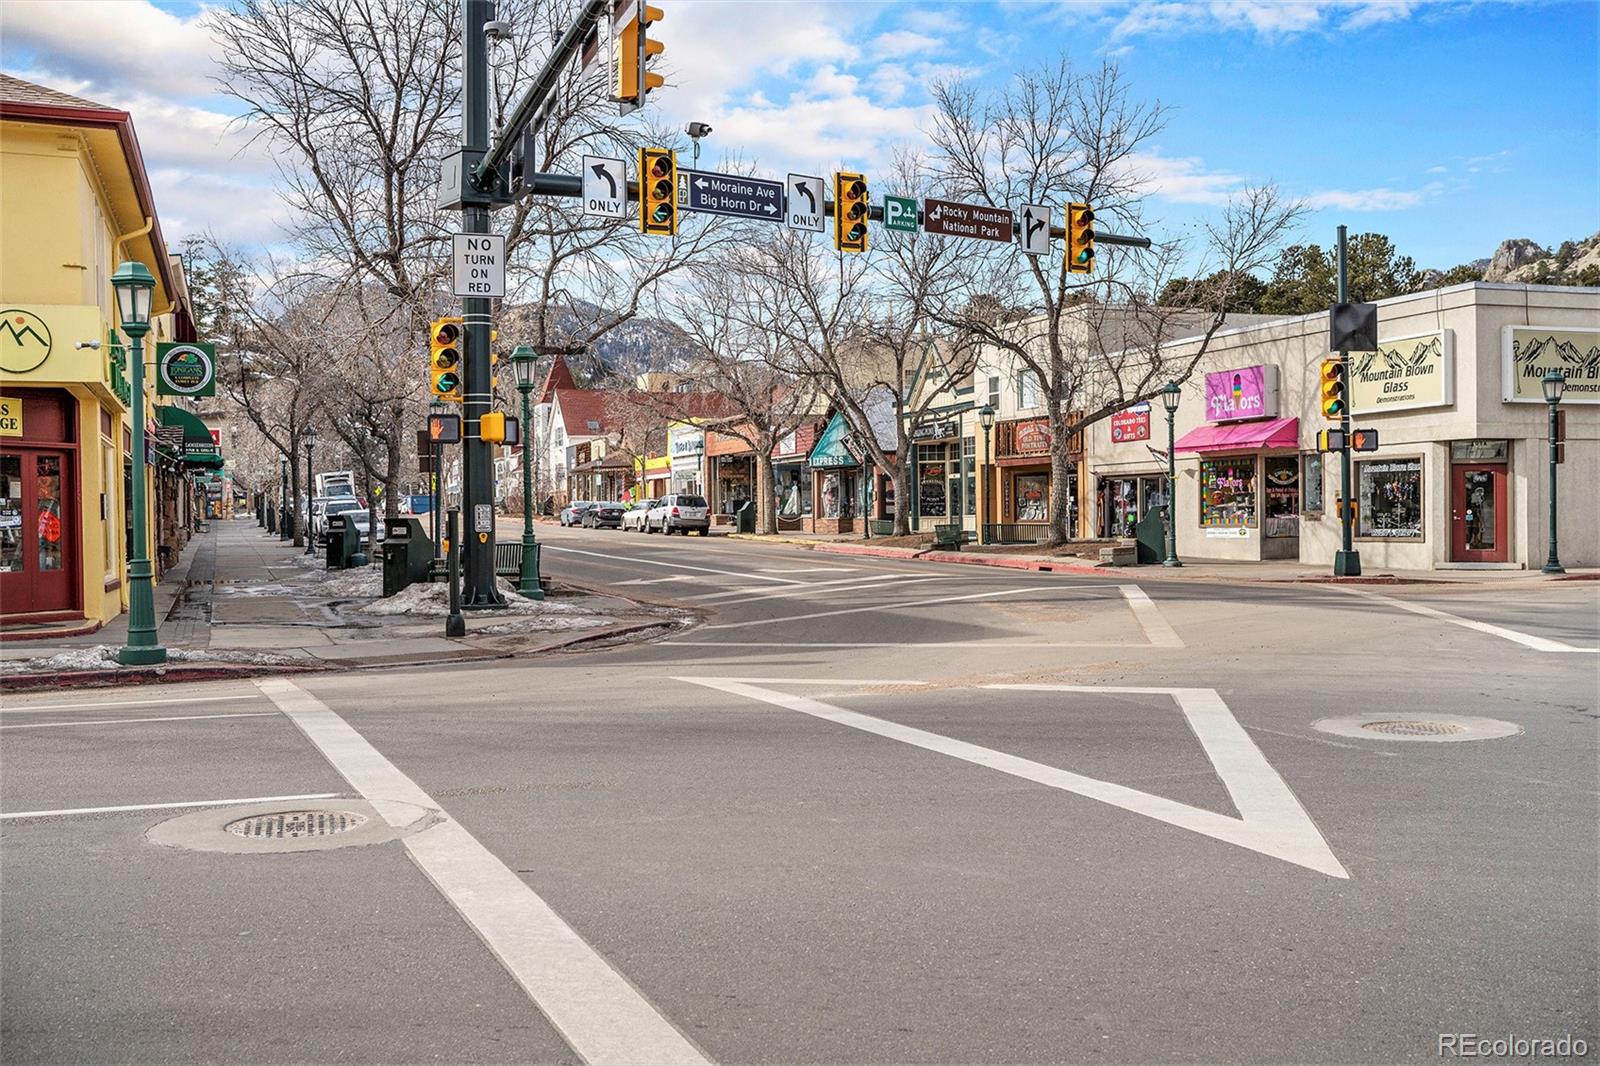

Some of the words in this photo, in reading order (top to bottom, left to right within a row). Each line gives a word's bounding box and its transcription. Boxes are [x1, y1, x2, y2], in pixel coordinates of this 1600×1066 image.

[711, 180, 753, 196] Moraine
[756, 186, 775, 199] Ave
[590, 199, 620, 213] ONLY
[700, 193, 718, 208] Big
[721, 196, 746, 210] Horn
[749, 200, 761, 212] Dr
[793, 214, 820, 227] ONLY
[943, 205, 968, 221] Rocky
[972, 209, 1010, 225] Mountain
[943, 220, 977, 234] National
[981, 225, 1000, 237] Park
[467, 238, 492, 251] NO
[464, 254, 495, 265] TURN
[471, 268, 488, 279] ON
[468, 282, 491, 293] RED
[1360, 367, 1402, 383] Mountain
[1405, 364, 1434, 377] Blown
[1523, 364, 1583, 379] Moutain
[1383, 381, 1409, 393] Glass
